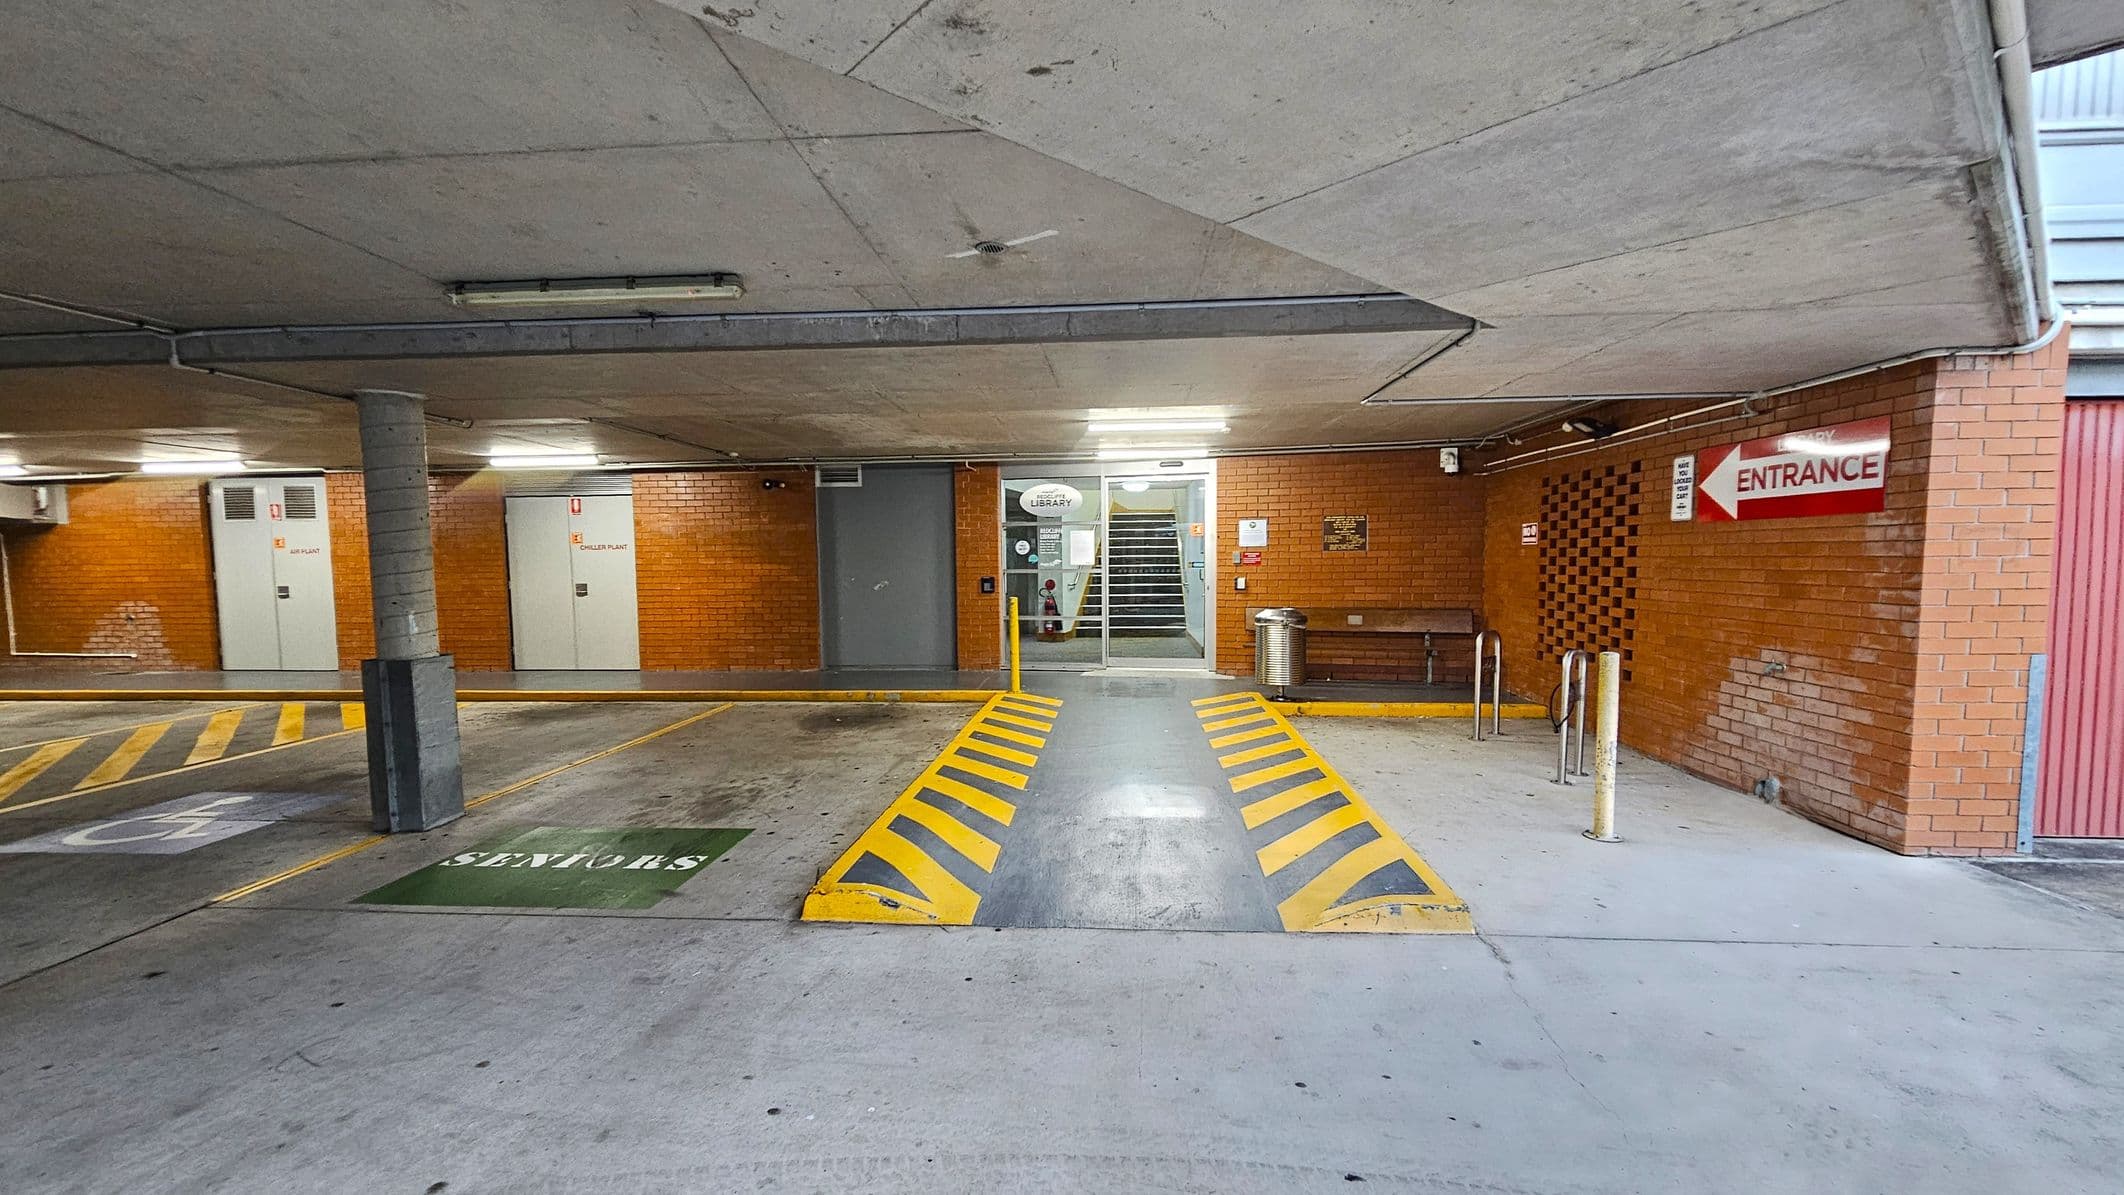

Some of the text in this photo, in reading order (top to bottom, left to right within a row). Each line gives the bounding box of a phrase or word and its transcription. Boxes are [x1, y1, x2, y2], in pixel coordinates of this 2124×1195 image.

[1737, 454, 1879, 492] ENTRANCE
[1030, 499, 1072, 507] LIBRARY
[441, 852, 708, 870] SENIORS
